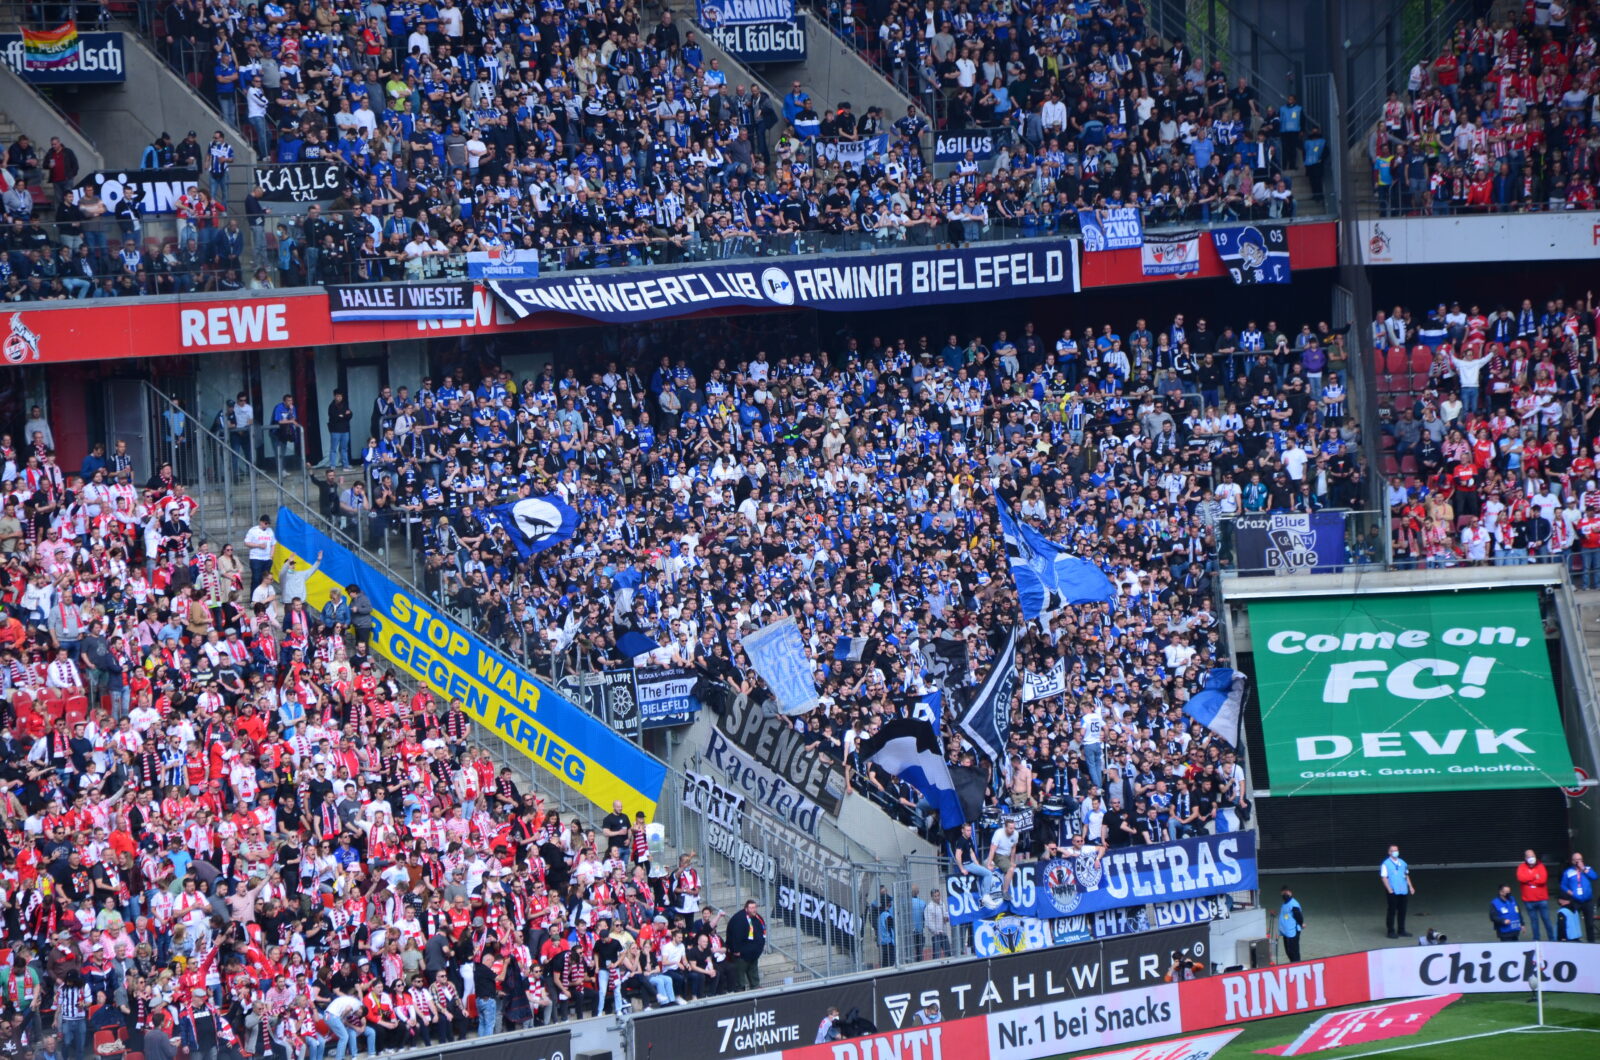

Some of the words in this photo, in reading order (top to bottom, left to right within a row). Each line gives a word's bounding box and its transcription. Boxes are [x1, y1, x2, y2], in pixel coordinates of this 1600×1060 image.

[256, 166, 339, 192] KALLE
[1103, 221, 1139, 238] ZWO
[516, 271, 764, 313] ANHÄNGERCLUB
[794, 263, 902, 301] ARMINIA
[912, 250, 1063, 293] BIELEFELD
[339, 289, 395, 308] HALLE
[407, 287, 465, 307] WESTF.
[182, 304, 289, 347] REWE
[1236, 516, 1274, 531] Crazy
[1275, 514, 1306, 528] Blue
[391, 592, 470, 656] STOP
[476, 652, 541, 713] WAR
[1267, 629, 1430, 655] Come
[1442, 626, 1531, 648] on,
[641, 687, 662, 699] The
[664, 683, 688, 696] Firm
[1322, 655, 1497, 704] FC!
[389, 633, 487, 717] GEGEN
[495, 702, 587, 786] KRIEG
[641, 700, 689, 715] BIELEFELD
[726, 693, 826, 798] SPENGE
[1296, 728, 1536, 761] DEVK
[705, 727, 821, 836] Raesfeld
[1300, 768, 1372, 779] Gesagt.
[1378, 766, 1441, 776] Getan.
[1447, 763, 1541, 773] Geholfen.
[683, 772, 746, 829] PORTA
[1103, 837, 1242, 899] ULTRAS
[1419, 949, 1578, 986] Chicko
[1222, 962, 1328, 1021] RINTI
[717, 1018, 736, 1053] 7
[734, 1010, 776, 1033] JAHRE
[1053, 1007, 1088, 1040] bei
[1095, 996, 1172, 1031] Snacks
[735, 1025, 800, 1051] GARANTIE
